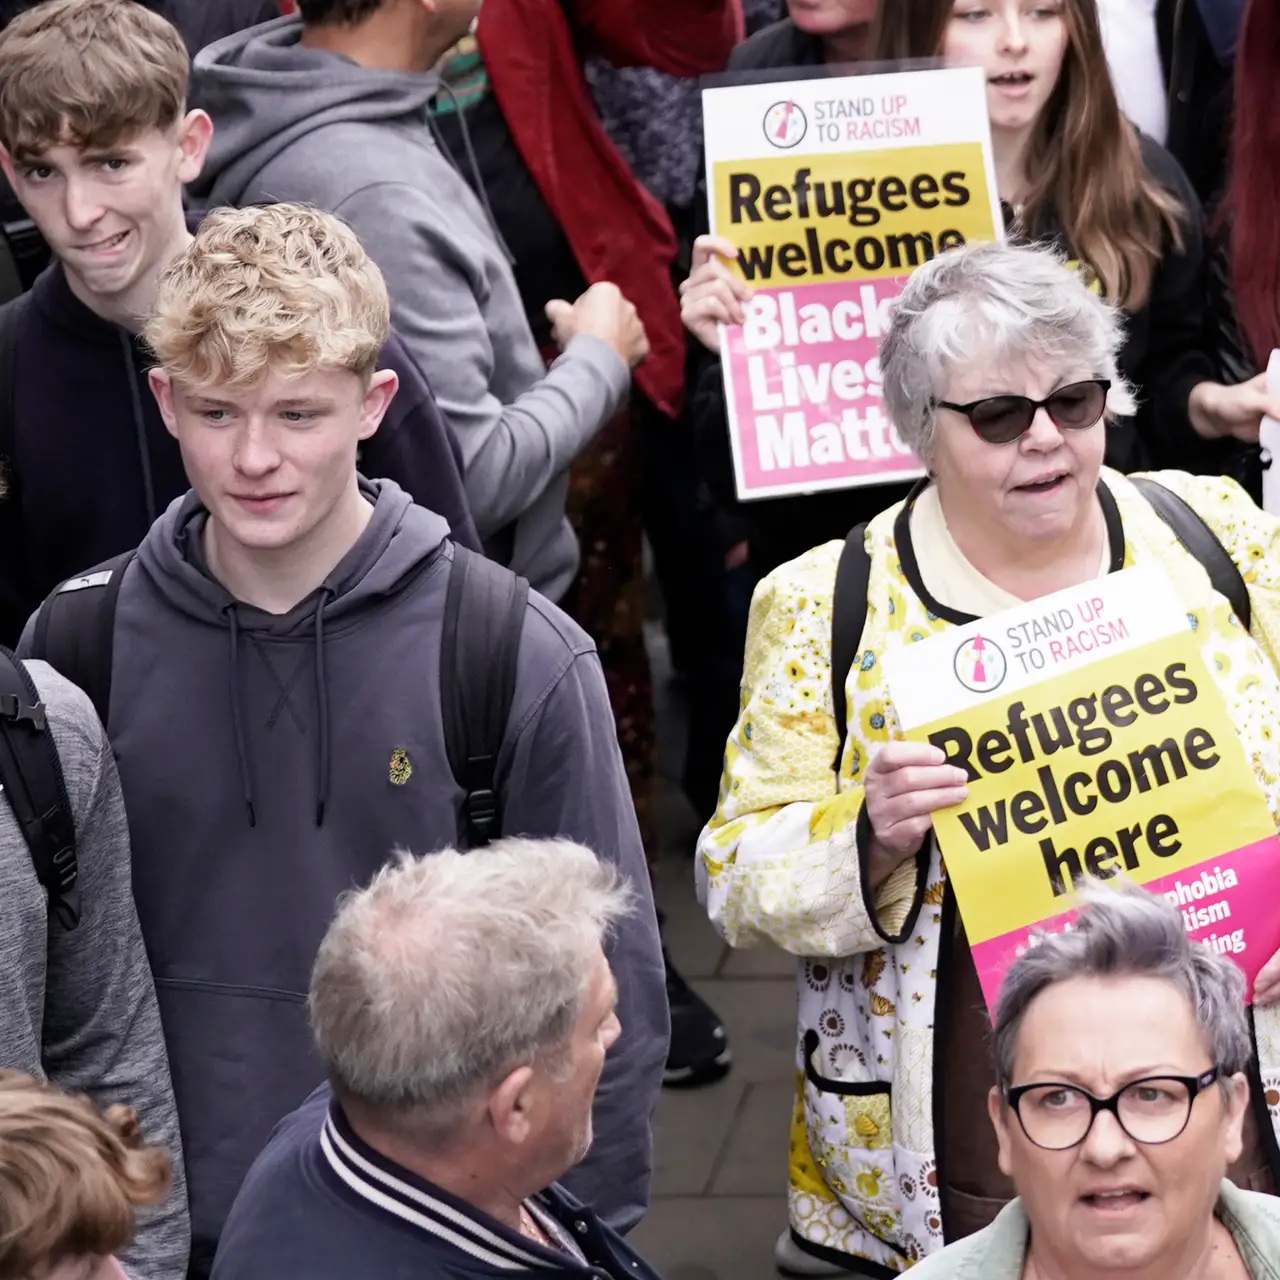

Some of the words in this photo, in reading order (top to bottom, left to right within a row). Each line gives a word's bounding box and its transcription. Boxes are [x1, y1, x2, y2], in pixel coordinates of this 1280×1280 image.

[814, 98, 874, 120] STAND
[881, 95, 907, 114] UP
[815, 123, 839, 142] TO
[846, 117, 921, 141] RACISM
[729, 167, 971, 228] Refugees
[737, 226, 968, 280] welcome
[742, 285, 896, 350] Black
[1006, 608, 1075, 649] STAND
[1079, 597, 1105, 624] UP
[1014, 647, 1045, 675] TO
[1048, 617, 1130, 664] RACISM
[927, 661, 1198, 783] Refugees
[957, 727, 1221, 852] welcome
[1039, 813, 1183, 898] here
